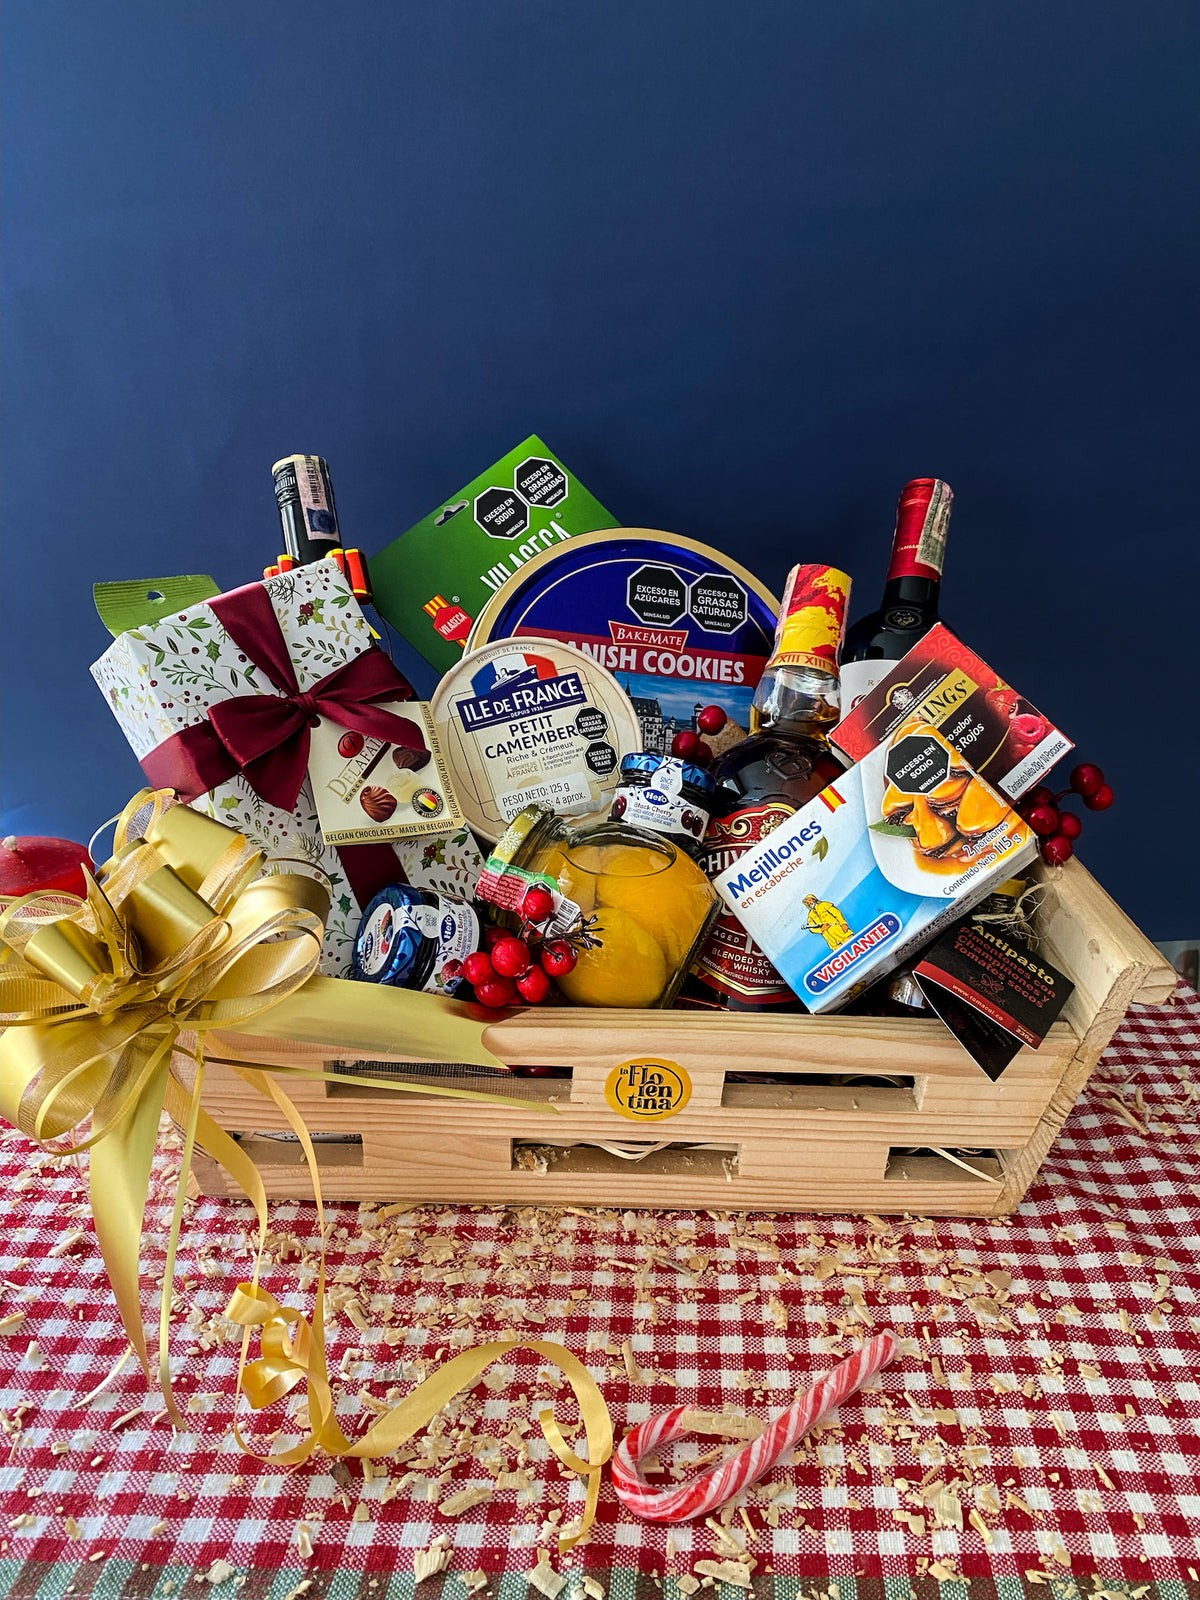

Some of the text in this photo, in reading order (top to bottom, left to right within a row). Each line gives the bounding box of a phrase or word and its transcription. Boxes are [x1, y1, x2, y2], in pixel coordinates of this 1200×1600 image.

[520, 464, 550, 488] EXCESO EN
[528, 471, 554, 493] GRASAS
[529, 474, 565, 503] SATURADAS
[483, 497, 515, 523] EXCESO EN
[494, 507, 515, 525] SODIO
[634, 594, 681, 606] AZÚCARES
[637, 585, 679, 598] EXCESO EN
[697, 588, 739, 600] EXCESO EN
[692, 605, 744, 620] SATURADAS
[697, 596, 739, 609] GRASAS
[439, 612, 467, 636] VILASECA
[643, 611, 671, 620] MINSALUD
[704, 620, 731, 628] MINSALUD
[477, 649, 501, 664] PRODUIT
[643, 650, 744, 683] COOKIES
[779, 654, 826, 668] XIII XIII
[463, 678, 580, 722] ILE DE FRANCE
[917, 682, 967, 724] INGS
[422, 704, 435, 728] BELGIUM
[510, 709, 531, 718] DEPUIS
[581, 719, 602, 728] GRASAS
[932, 712, 946, 726] NDON
[430, 729, 437, 738] IN
[509, 714, 553, 737] PETIT
[579, 724, 607, 733] SATURADAS
[952, 714, 972, 737] sabor
[958, 723, 985, 748] Rojos
[432, 739, 441, 753] MADE
[485, 724, 579, 759] CAMEMBER
[506, 753, 529, 764] Riche
[588, 749, 604, 757] EXCESO
[591, 754, 611, 762] GRASAS
[895, 745, 936, 779] EXCESO EN
[437, 758, 453, 793] CHOCOLATES
[512, 766, 539, 777] FRANCE
[910, 759, 934, 779] SODIO
[918, 768, 946, 791] MINSALUD
[1006, 773, 1029, 794] Contenido
[502, 782, 570, 807] PESO NETO: 125 g
[555, 797, 561, 805] 4
[562, 791, 586, 804] aprox.
[645, 791, 667, 803] Hero
[448, 794, 461, 819] BELGIAN
[651, 805, 673, 818] Cherry
[325, 829, 355, 843] BELGIAN
[355, 826, 395, 839] CHOCOLATES
[399, 824, 418, 834] MADE
[419, 823, 426, 832] IN
[427, 820, 455, 831] BELGIUM
[963, 822, 1010, 857] 2 porciones
[698, 850, 747, 873] CHIV
[726, 820, 822, 899] Mejillones
[943, 833, 1022, 895] Contenido Neto 115 g
[741, 895, 754, 909] en
[755, 856, 804, 898] escabeche
[443, 915, 453, 940] Hero
[713, 929, 740, 944] AGED
[454, 930, 463, 952] Forest
[711, 947, 754, 965] BLENDED
[816, 922, 890, 983] VIGILANTE
[959, 926, 1056, 998] Pimentones con
[970, 924, 1055, 986] Antipasto
[724, 968, 744, 980] MATURED
[733, 962, 771, 976] WHISKY
[952, 984, 1003, 1021] www.tomacol.co
[1007, 979, 1043, 1008] secos
[1041, 995, 1050, 1003] y
[628, 1065, 664, 1086] Flo
[638, 1081, 673, 1097] ren
[627, 1093, 672, 1110] tina
